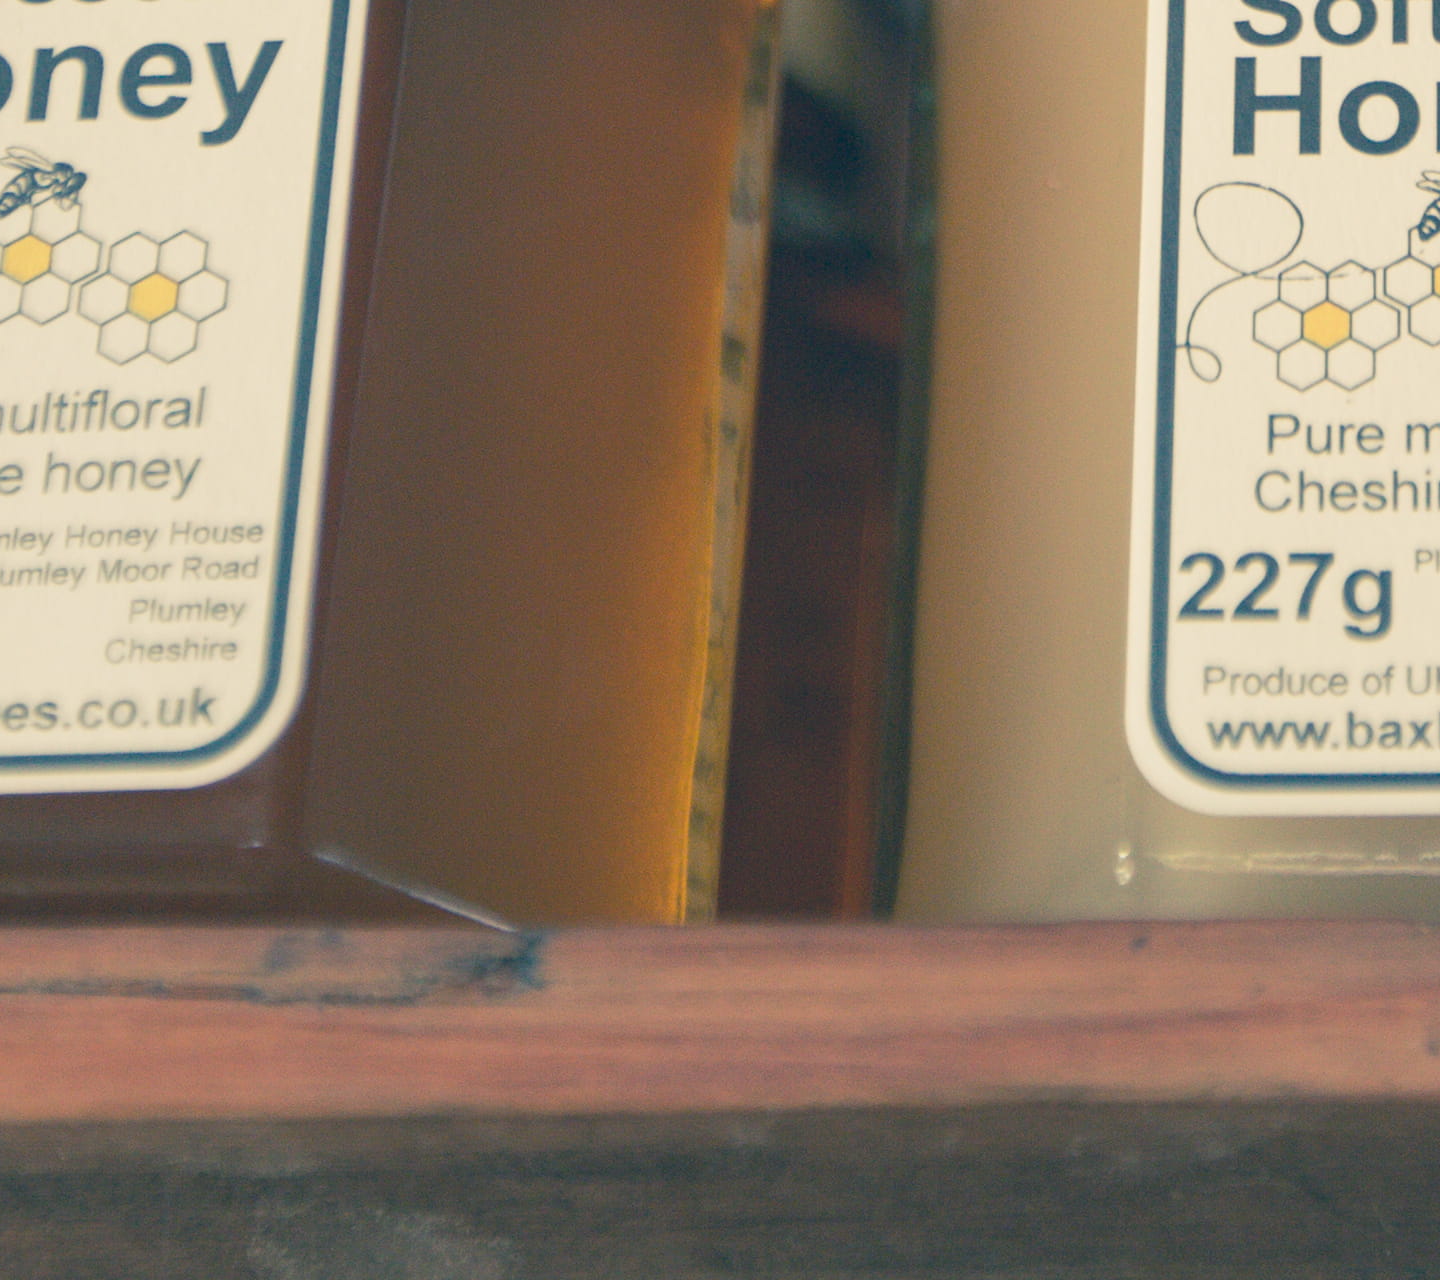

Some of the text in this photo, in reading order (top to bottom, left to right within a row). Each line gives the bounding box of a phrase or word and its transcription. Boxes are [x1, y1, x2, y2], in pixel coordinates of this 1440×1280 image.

[1267, 413, 1385, 455] Pure
[43, 451, 202, 500] honey
[66, 525, 159, 550] Honey
[171, 521, 265, 544] House
[98, 558, 173, 582] Moor
[183, 555, 260, 579] Road
[1178, 551, 1393, 640] 227g
[130, 597, 247, 625] Plumley
[106, 637, 239, 663] Cheshire
[1203, 664, 1349, 696] Produce
[1361, 664, 1395, 695] of
